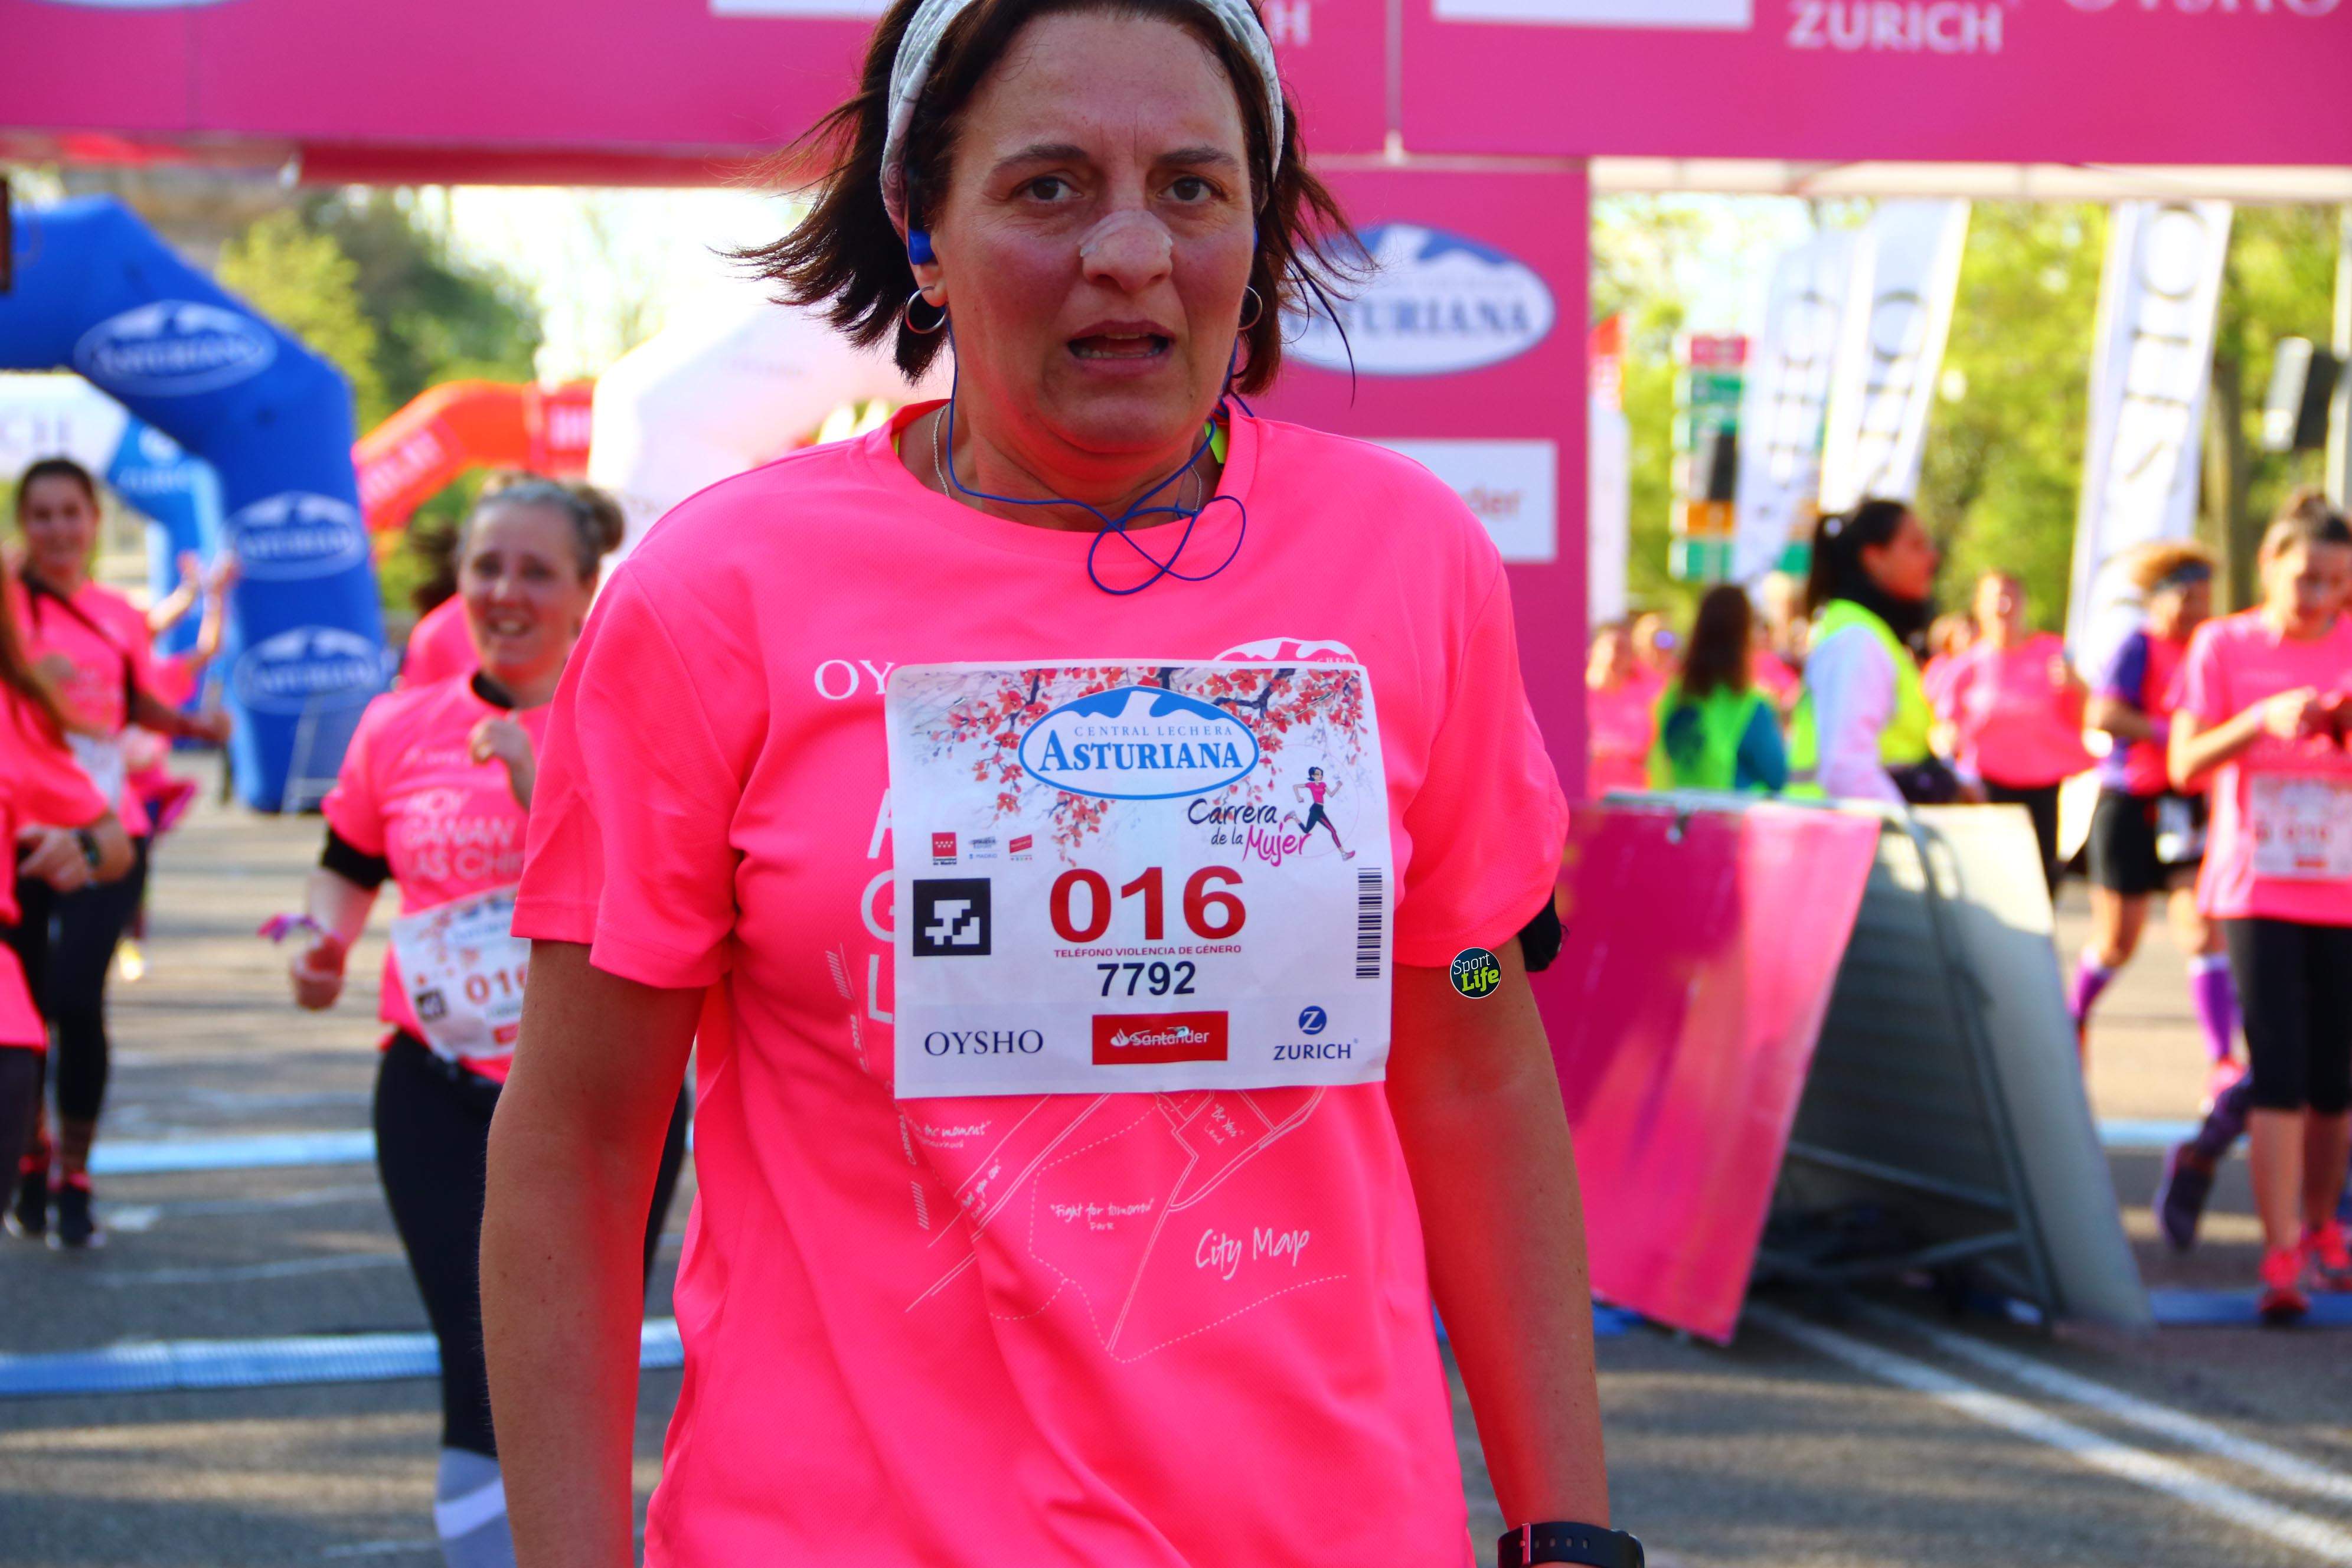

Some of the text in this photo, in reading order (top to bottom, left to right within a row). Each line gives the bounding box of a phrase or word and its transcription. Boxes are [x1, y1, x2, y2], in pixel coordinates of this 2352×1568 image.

[1786, 0, 2003, 53] ZURICH
[1074, 726, 1233, 737] CENTRAL LECHERA
[1038, 729, 1244, 772] ASTURIANA
[1188, 798, 1278, 825] Carrera
[1211, 822, 1312, 867] de la Mujer
[1049, 865, 1246, 943] 016
[1054, 944, 1242, 958] TELÉFONO VIOLENCIA DE GÉNERO
[1096, 961, 1196, 997] 7792
[925, 1029, 1044, 1056] OYSHO
[1132, 1031, 1210, 1046] Santander
[1272, 1043, 1352, 1061] ZURICH
[1195, 1227, 1310, 1280] City Map
